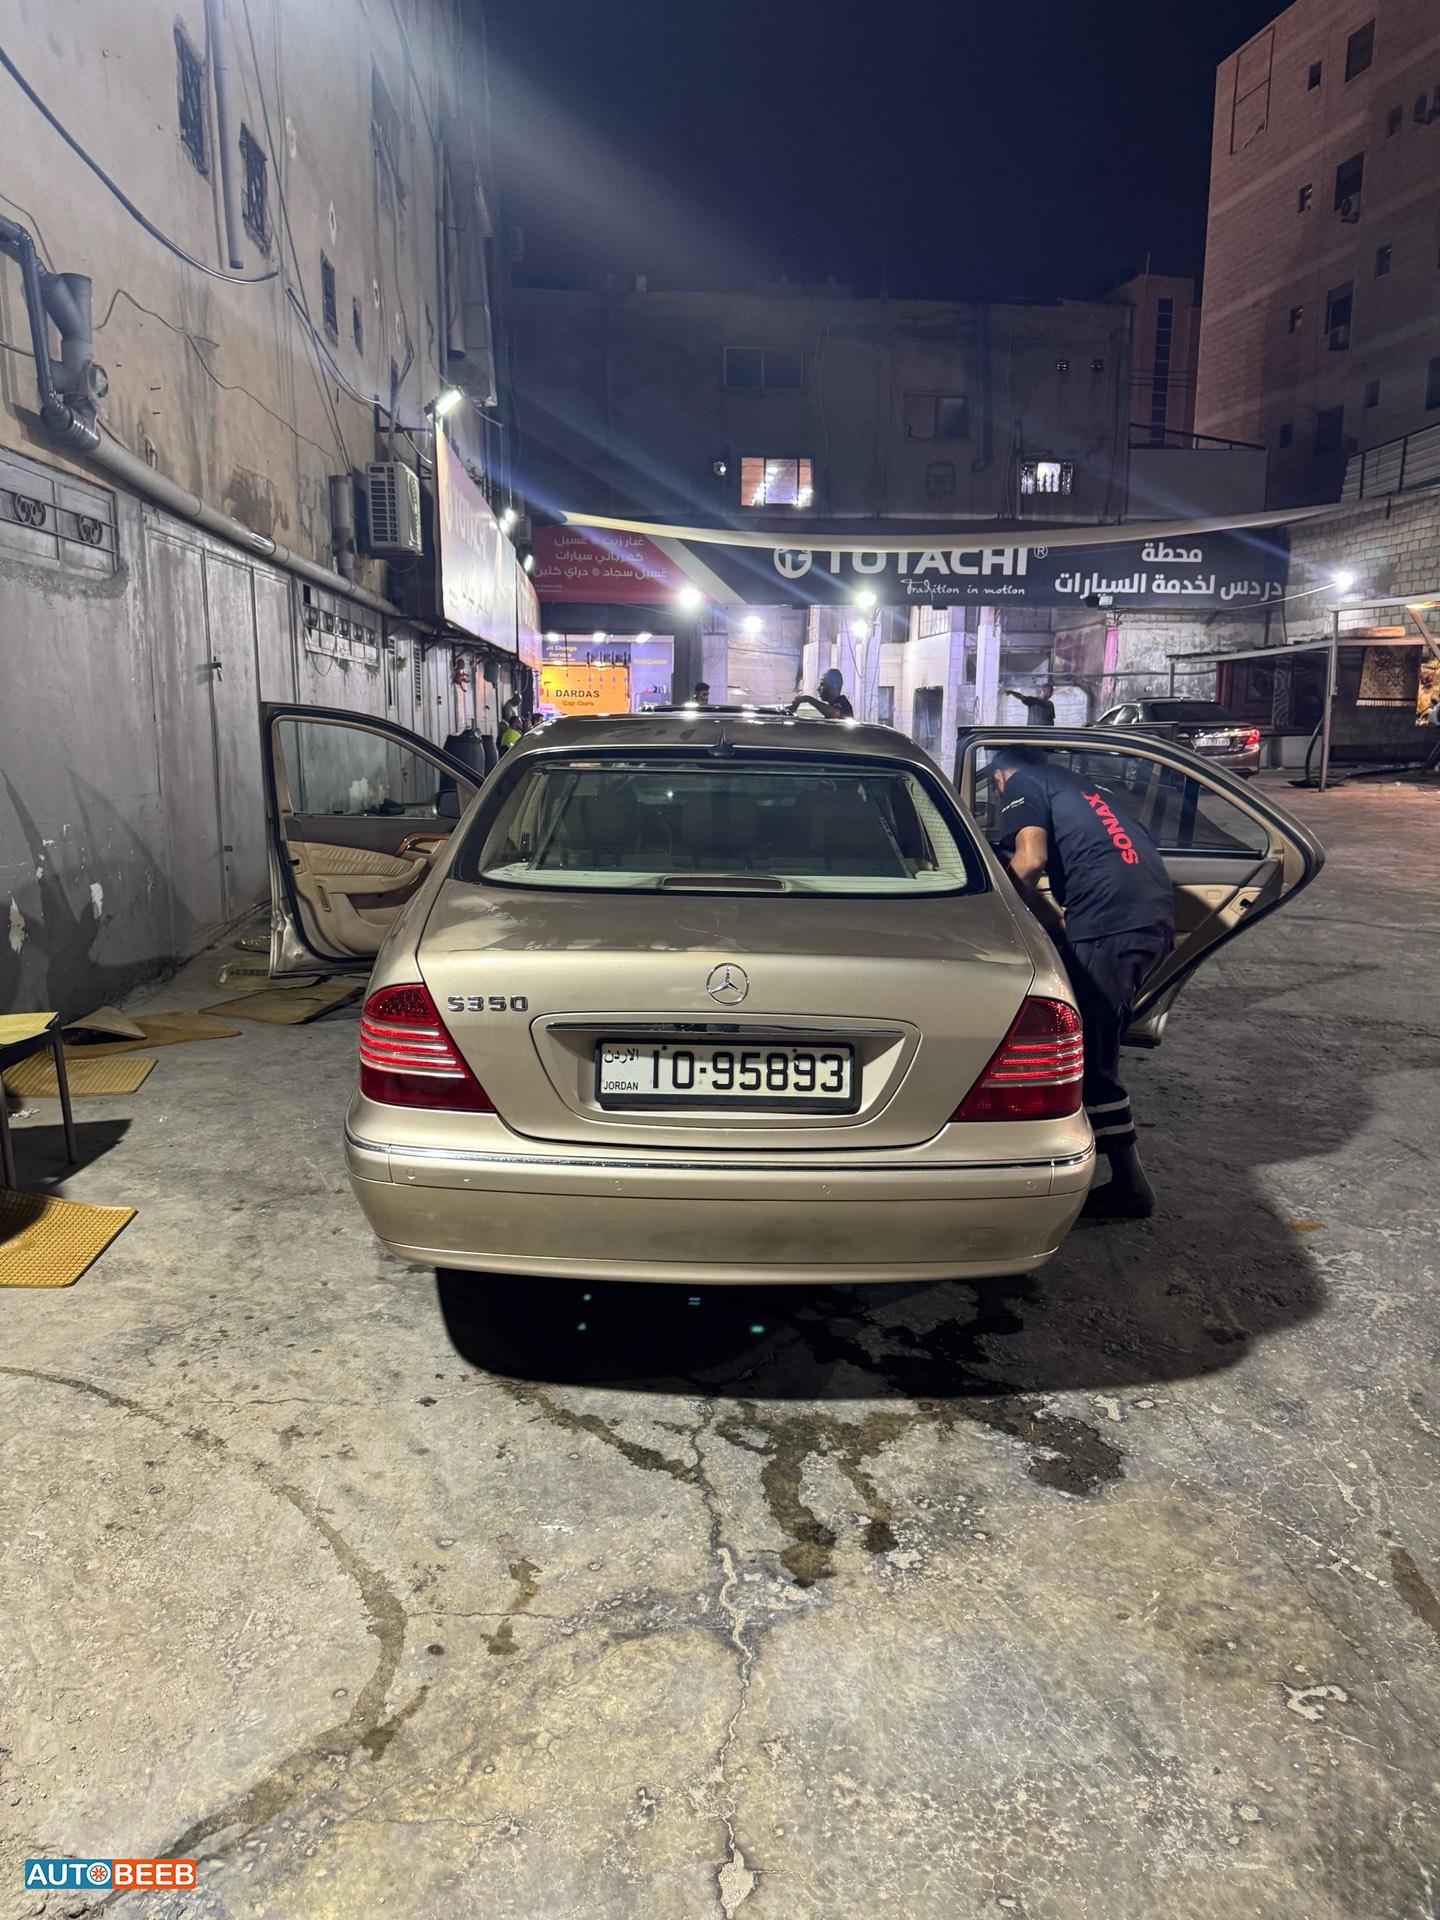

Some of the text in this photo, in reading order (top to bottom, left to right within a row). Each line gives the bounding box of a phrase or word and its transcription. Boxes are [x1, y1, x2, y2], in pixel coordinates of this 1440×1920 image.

[554, 535, 587, 546] غسيل
[555, 551, 593, 562] سيارات
[1141, 542, 1203, 563] محطة
[564, 567, 589, 579] دراي
[603, 567, 633, 577] سجاد
[634, 568, 668, 580] غسيل
[900, 579, 1025, 601] Tradition in motion
[1054, 572, 1283, 601] دردس لخدمة السيارات
[555, 689, 600, 698] DARDAS
[1080, 791, 1139, 865] SONAX
[447, 995, 529, 1012] S350
[603, 1080, 639, 1091] JORDAN
